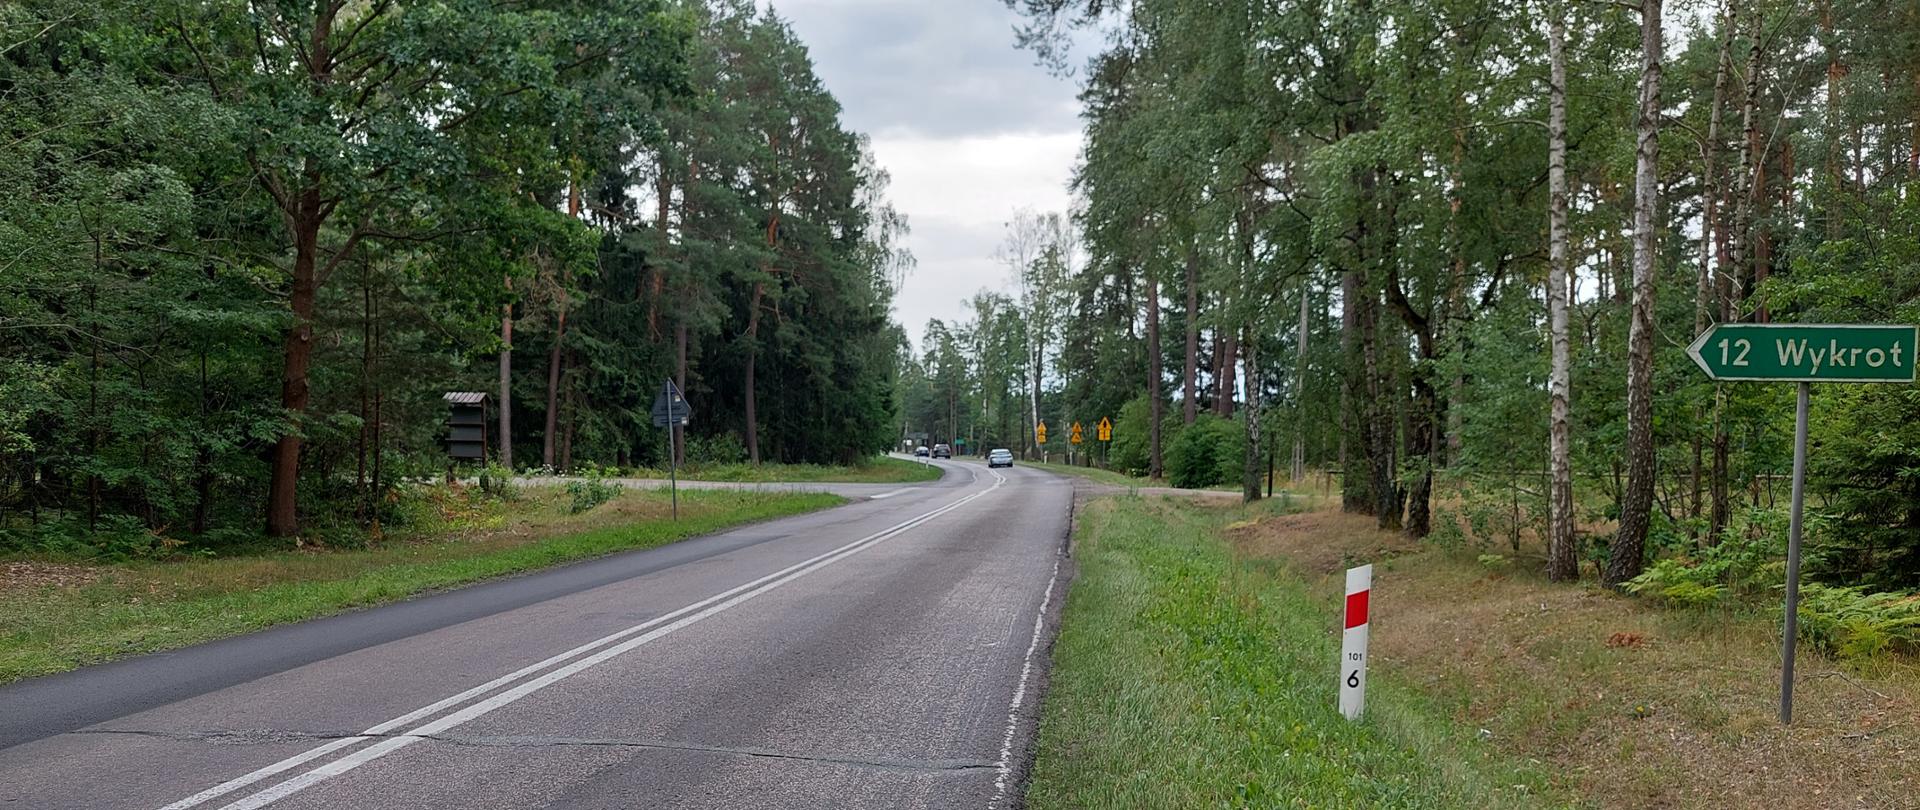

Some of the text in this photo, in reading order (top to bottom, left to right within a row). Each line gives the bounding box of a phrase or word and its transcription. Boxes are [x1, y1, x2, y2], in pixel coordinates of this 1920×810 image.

[1718, 338, 1902, 375] 12 Wykrot
[1348, 652, 1362, 661] 101
[1347, 669, 1359, 688] 6
